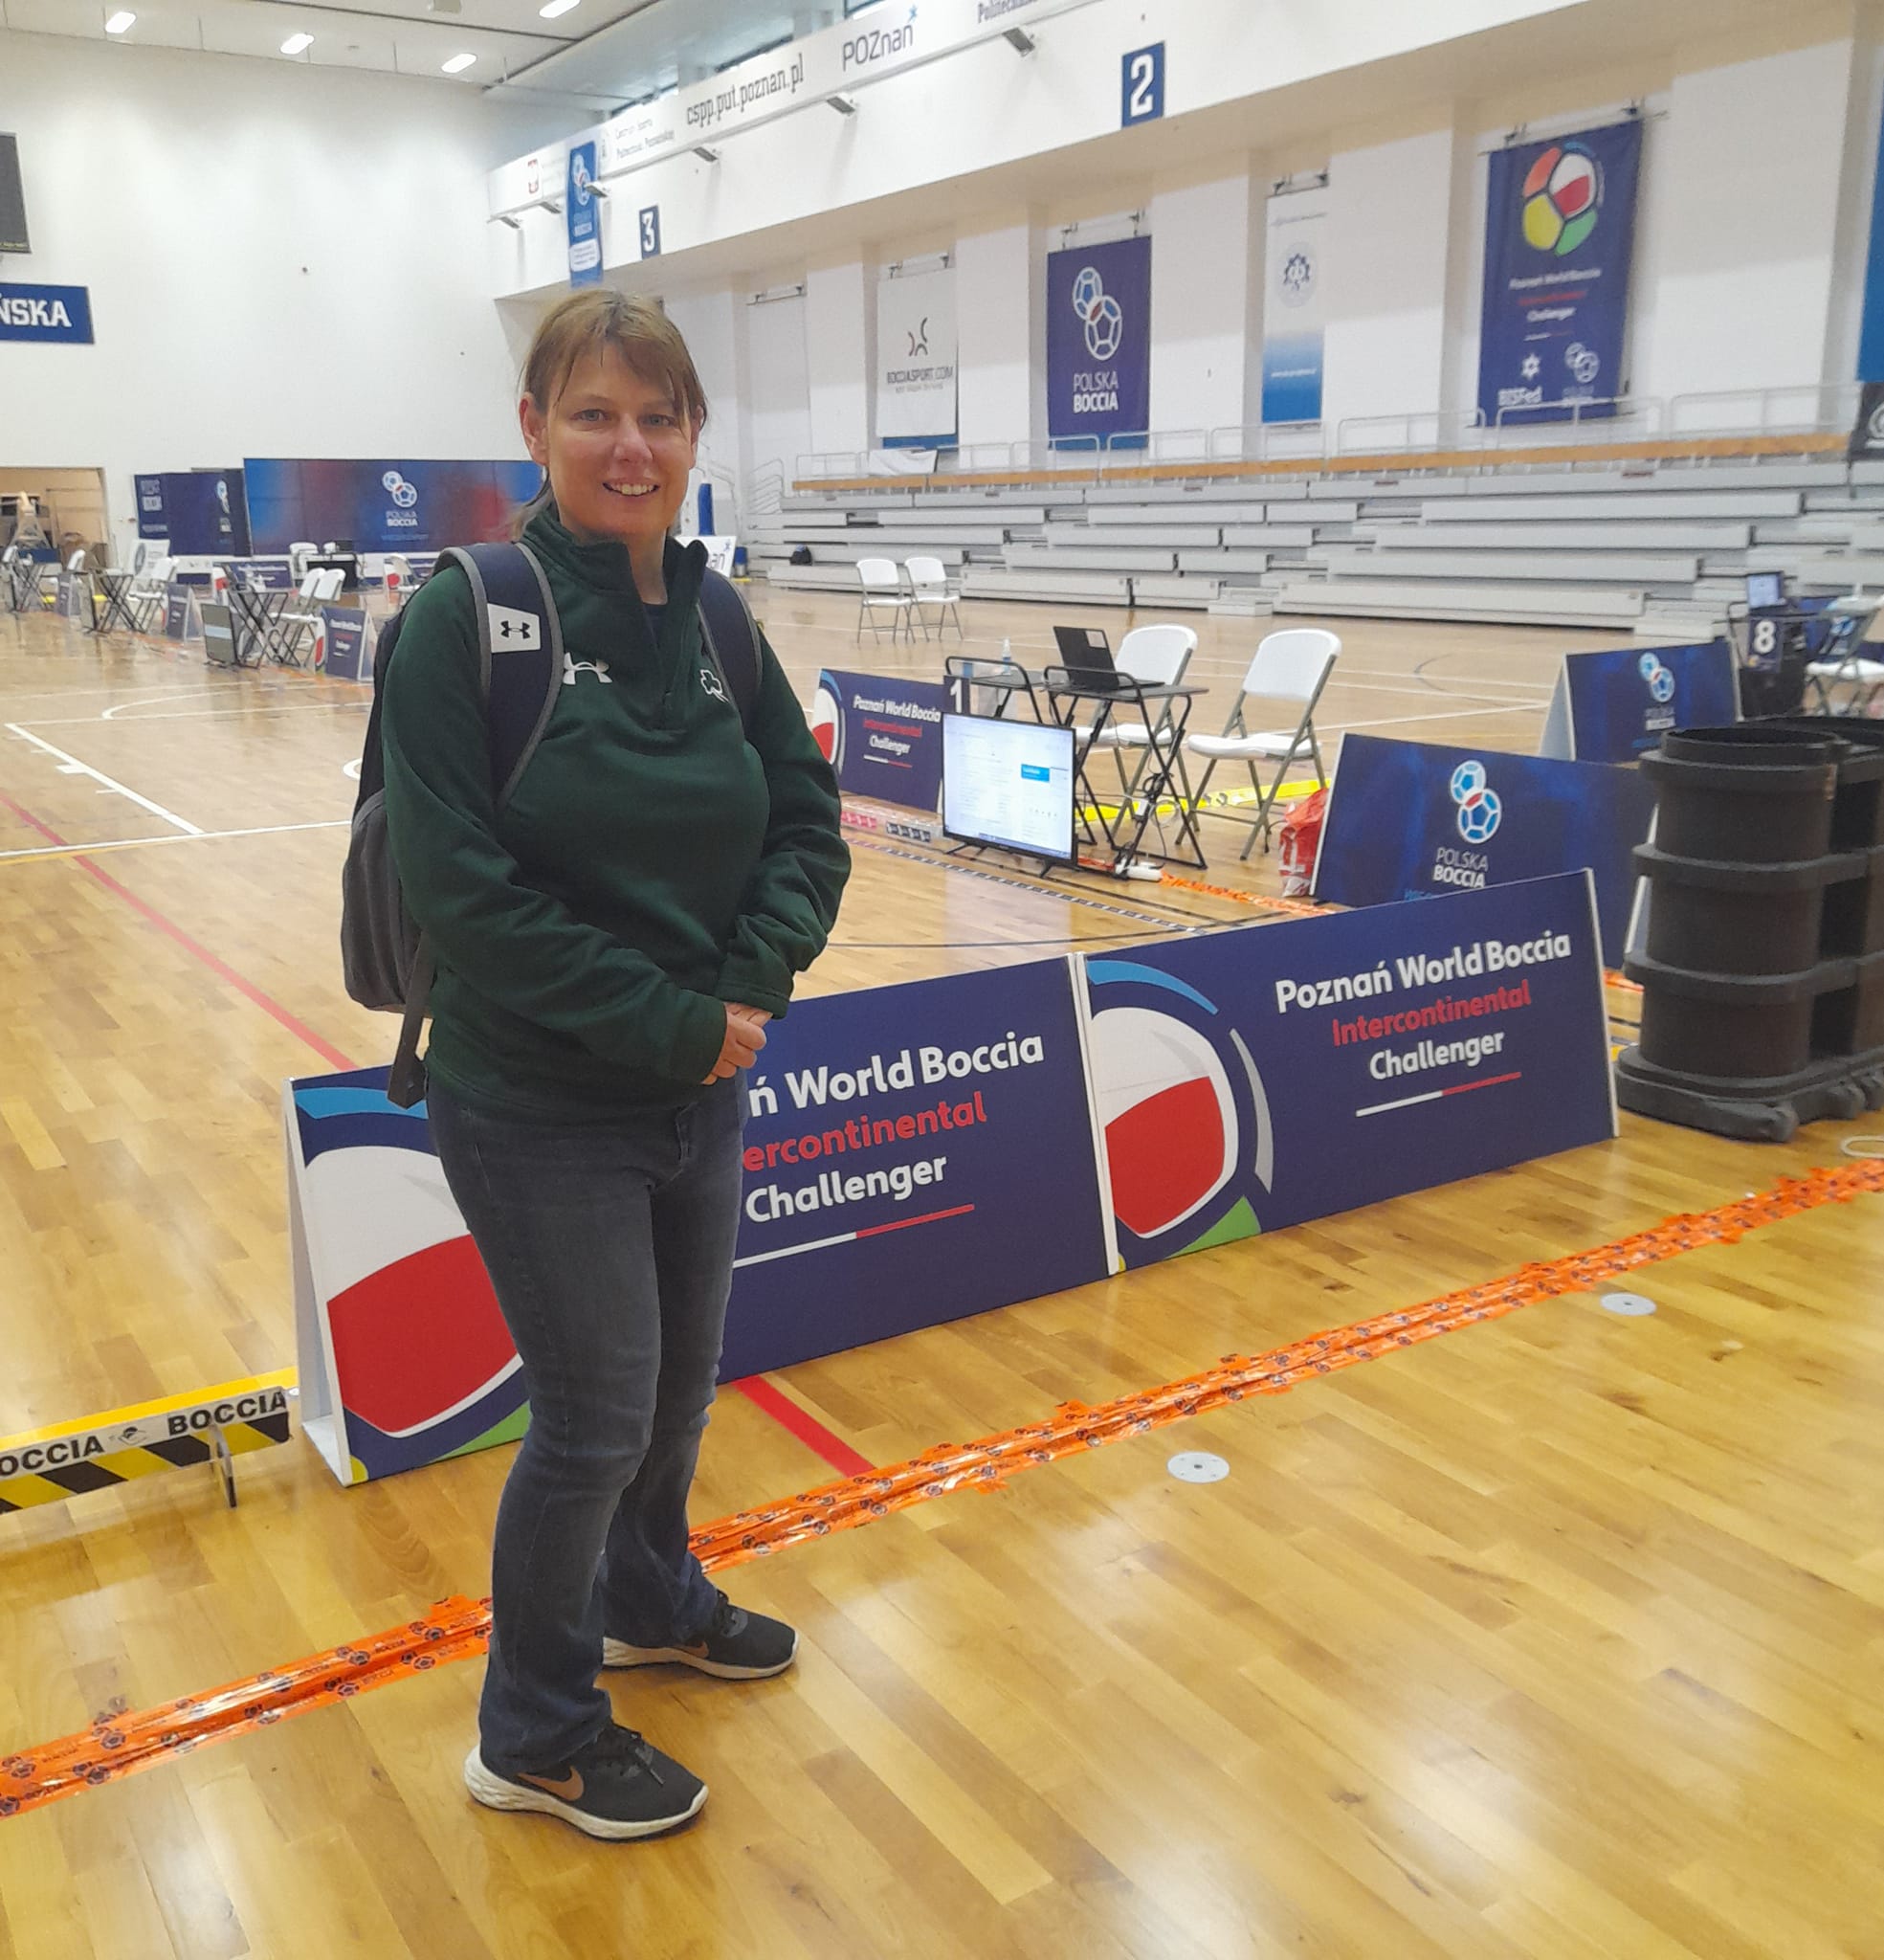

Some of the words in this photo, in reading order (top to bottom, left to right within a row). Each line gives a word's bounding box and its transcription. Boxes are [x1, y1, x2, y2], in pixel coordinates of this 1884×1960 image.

[686, 53, 805, 128] cspp.put.poznan.pl
[1130, 53, 1155, 119] 2
[641, 210, 656, 254] 3
[1073, 370, 1119, 393] POLSKA
[1073, 390, 1119, 414] BOCCIA
[1754, 619, 1777, 654] 8
[950, 679, 963, 714] 1
[1432, 864, 1486, 889] BOCCIA
[1435, 846, 1489, 871] POLSKA
[1274, 960, 1394, 1014] Poznań
[1396, 943, 1487, 990] World
[1484, 929, 1572, 973] Boccia
[1332, 978, 1533, 1047] Intercontinental
[785, 1048, 916, 1110] World
[919, 1031, 1046, 1085] Boccia
[1368, 1032, 1506, 1081] Challenger
[742, 1090, 988, 1172] ercontinental
[745, 1156, 948, 1224] Challenger
[167, 1391, 287, 1437] BOCCIA
[0, 1435, 105, 1478] OCCIA
